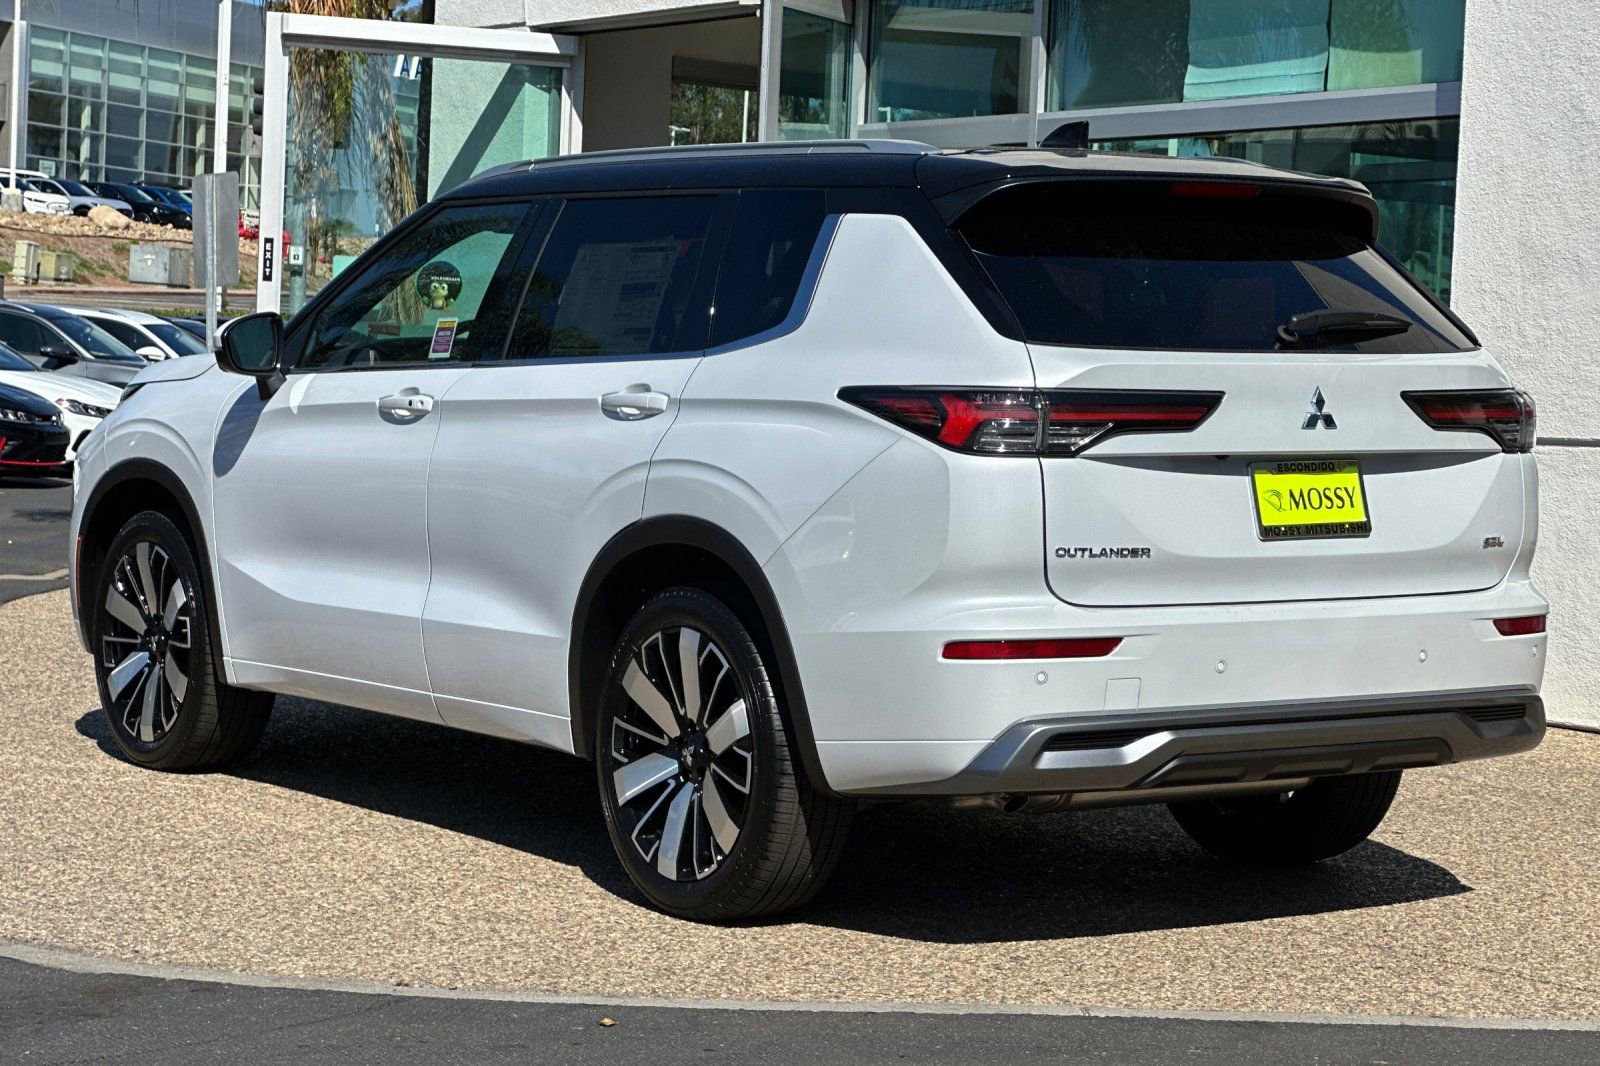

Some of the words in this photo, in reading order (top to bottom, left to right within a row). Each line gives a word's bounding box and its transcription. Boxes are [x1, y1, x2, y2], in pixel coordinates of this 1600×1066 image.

[1277, 461, 1335, 472] ESCONDIDO
[1288, 486, 1356, 511] MOSSY
[1264, 525, 1302, 537] MOSSY
[1305, 523, 1368, 534] MITSUBISHI
[1055, 547, 1151, 558] OUTLANDER
